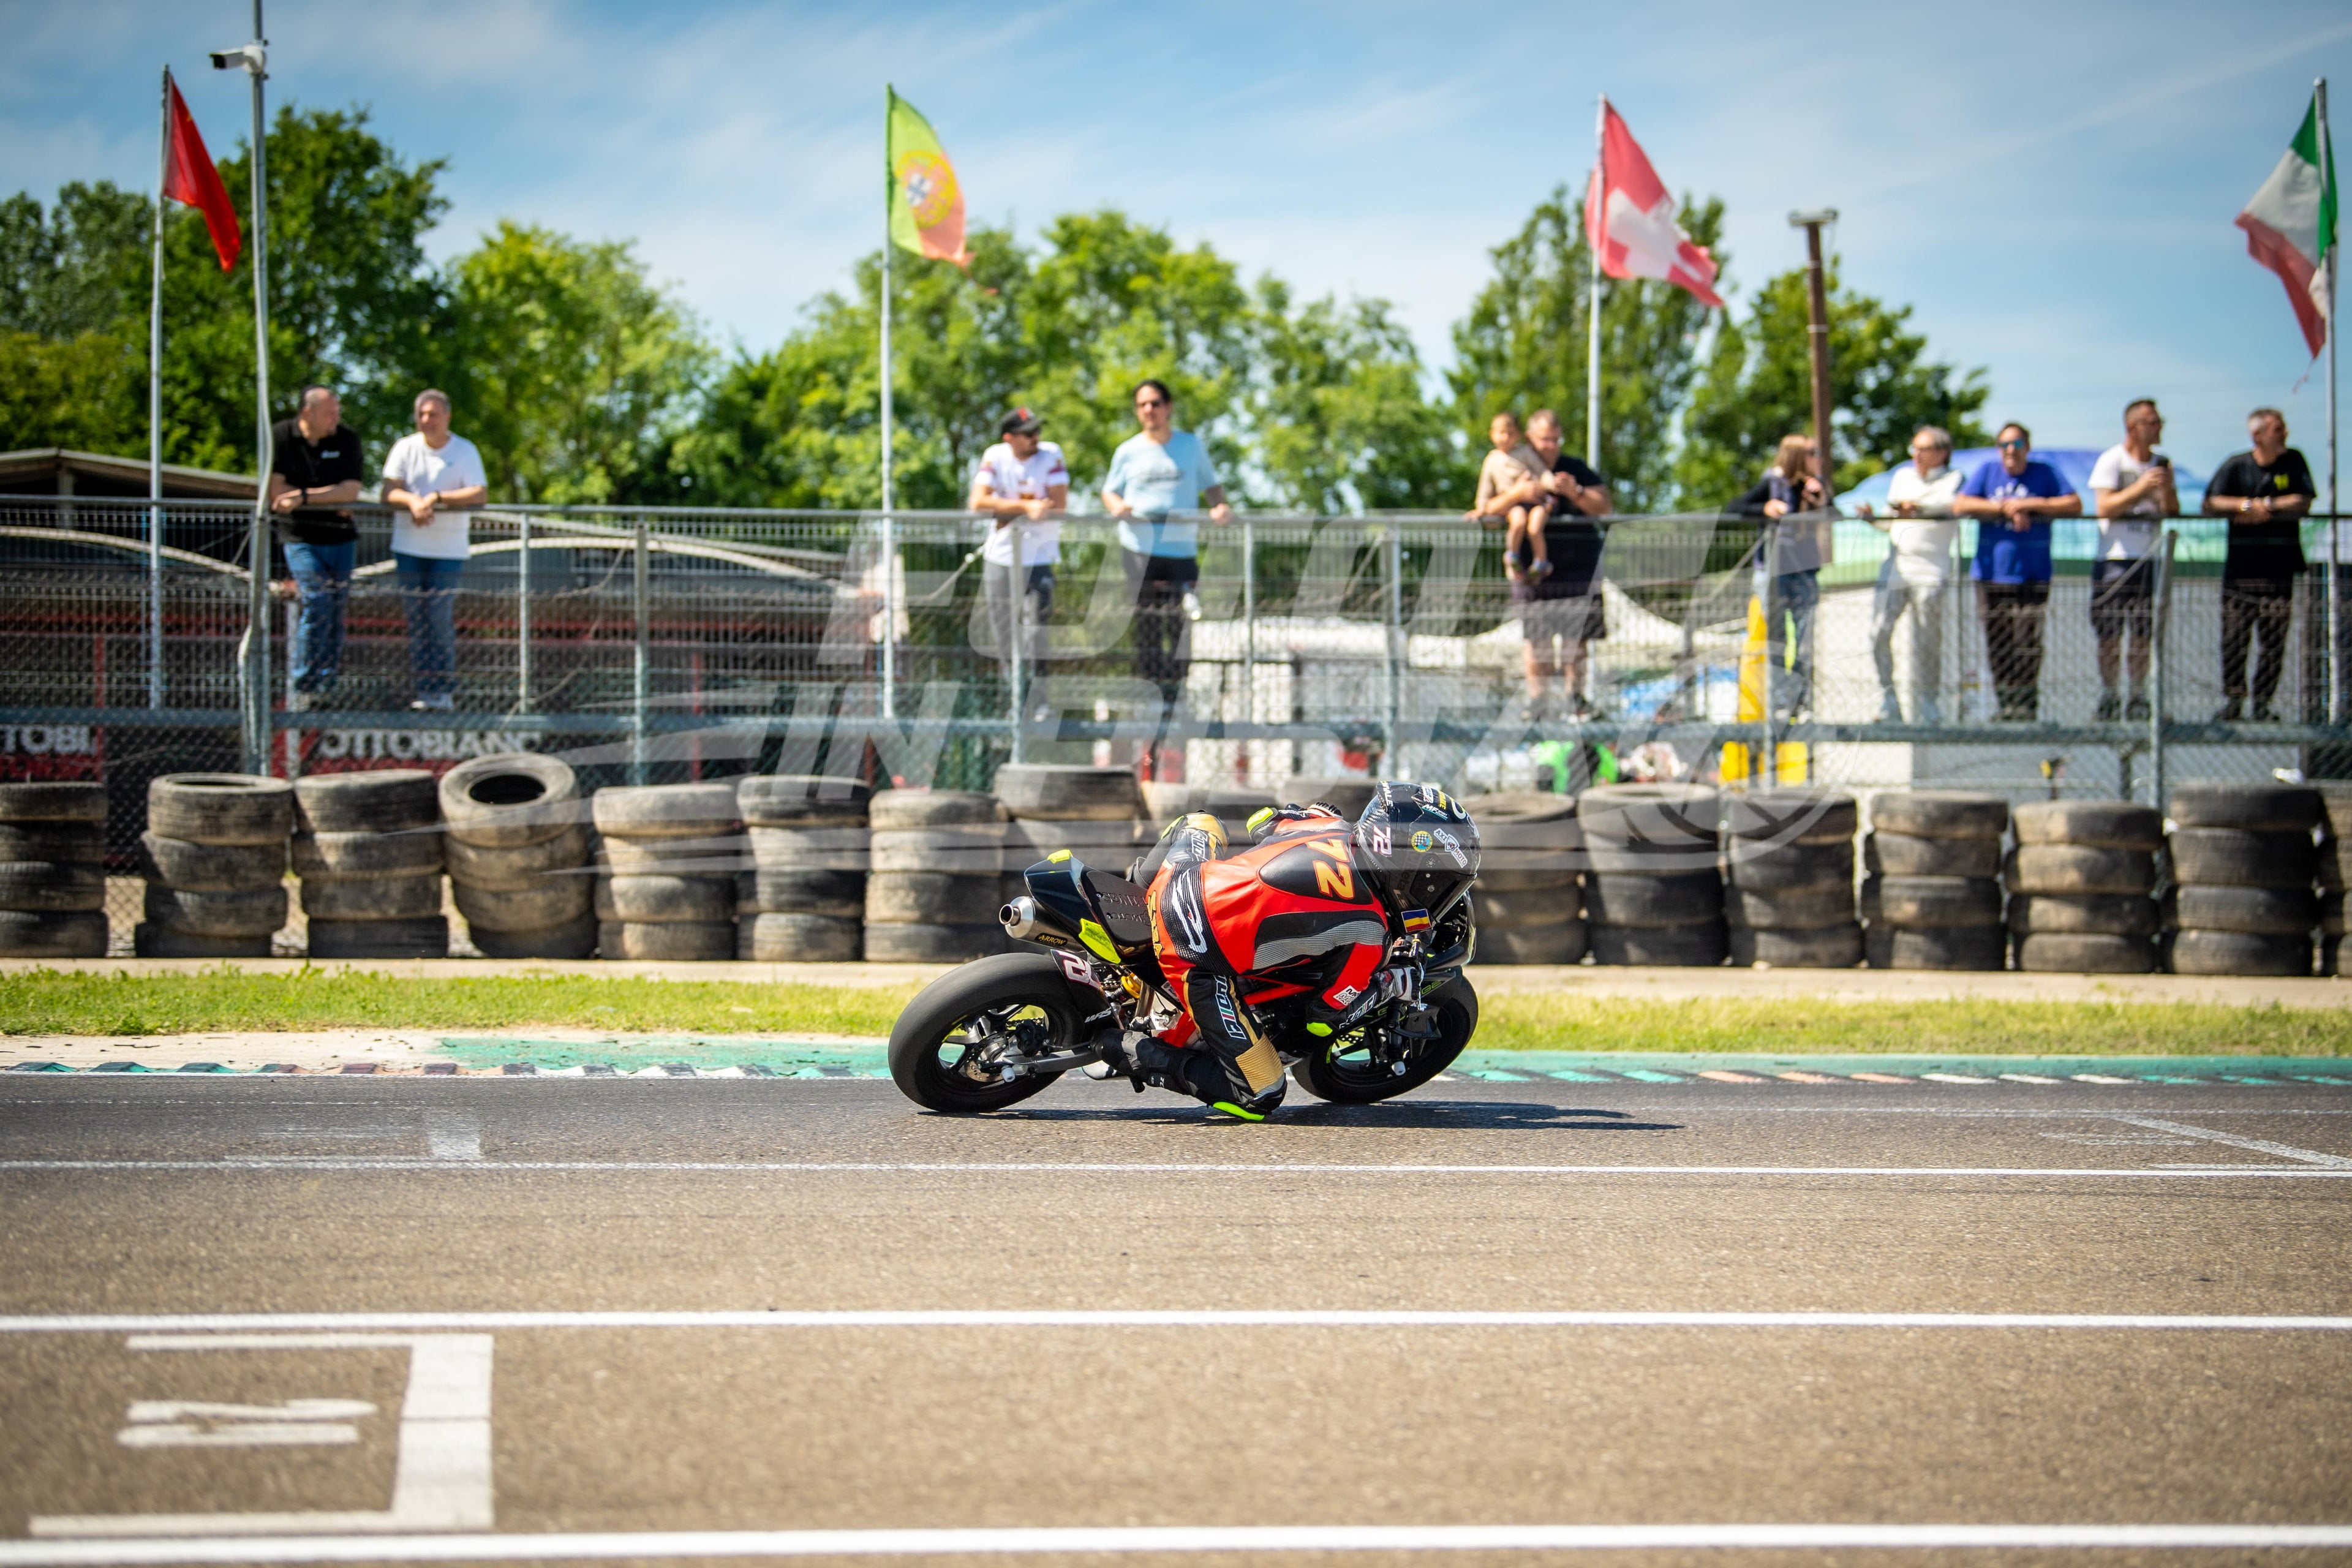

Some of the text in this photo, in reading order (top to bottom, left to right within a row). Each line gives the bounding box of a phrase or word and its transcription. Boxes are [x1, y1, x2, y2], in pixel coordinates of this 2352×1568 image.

[1373, 825, 1392, 856] 72
[1454, 848, 1468, 866] MOTO
[1305, 839, 1355, 900] 72
[1038, 934, 1066, 946] ARROW
